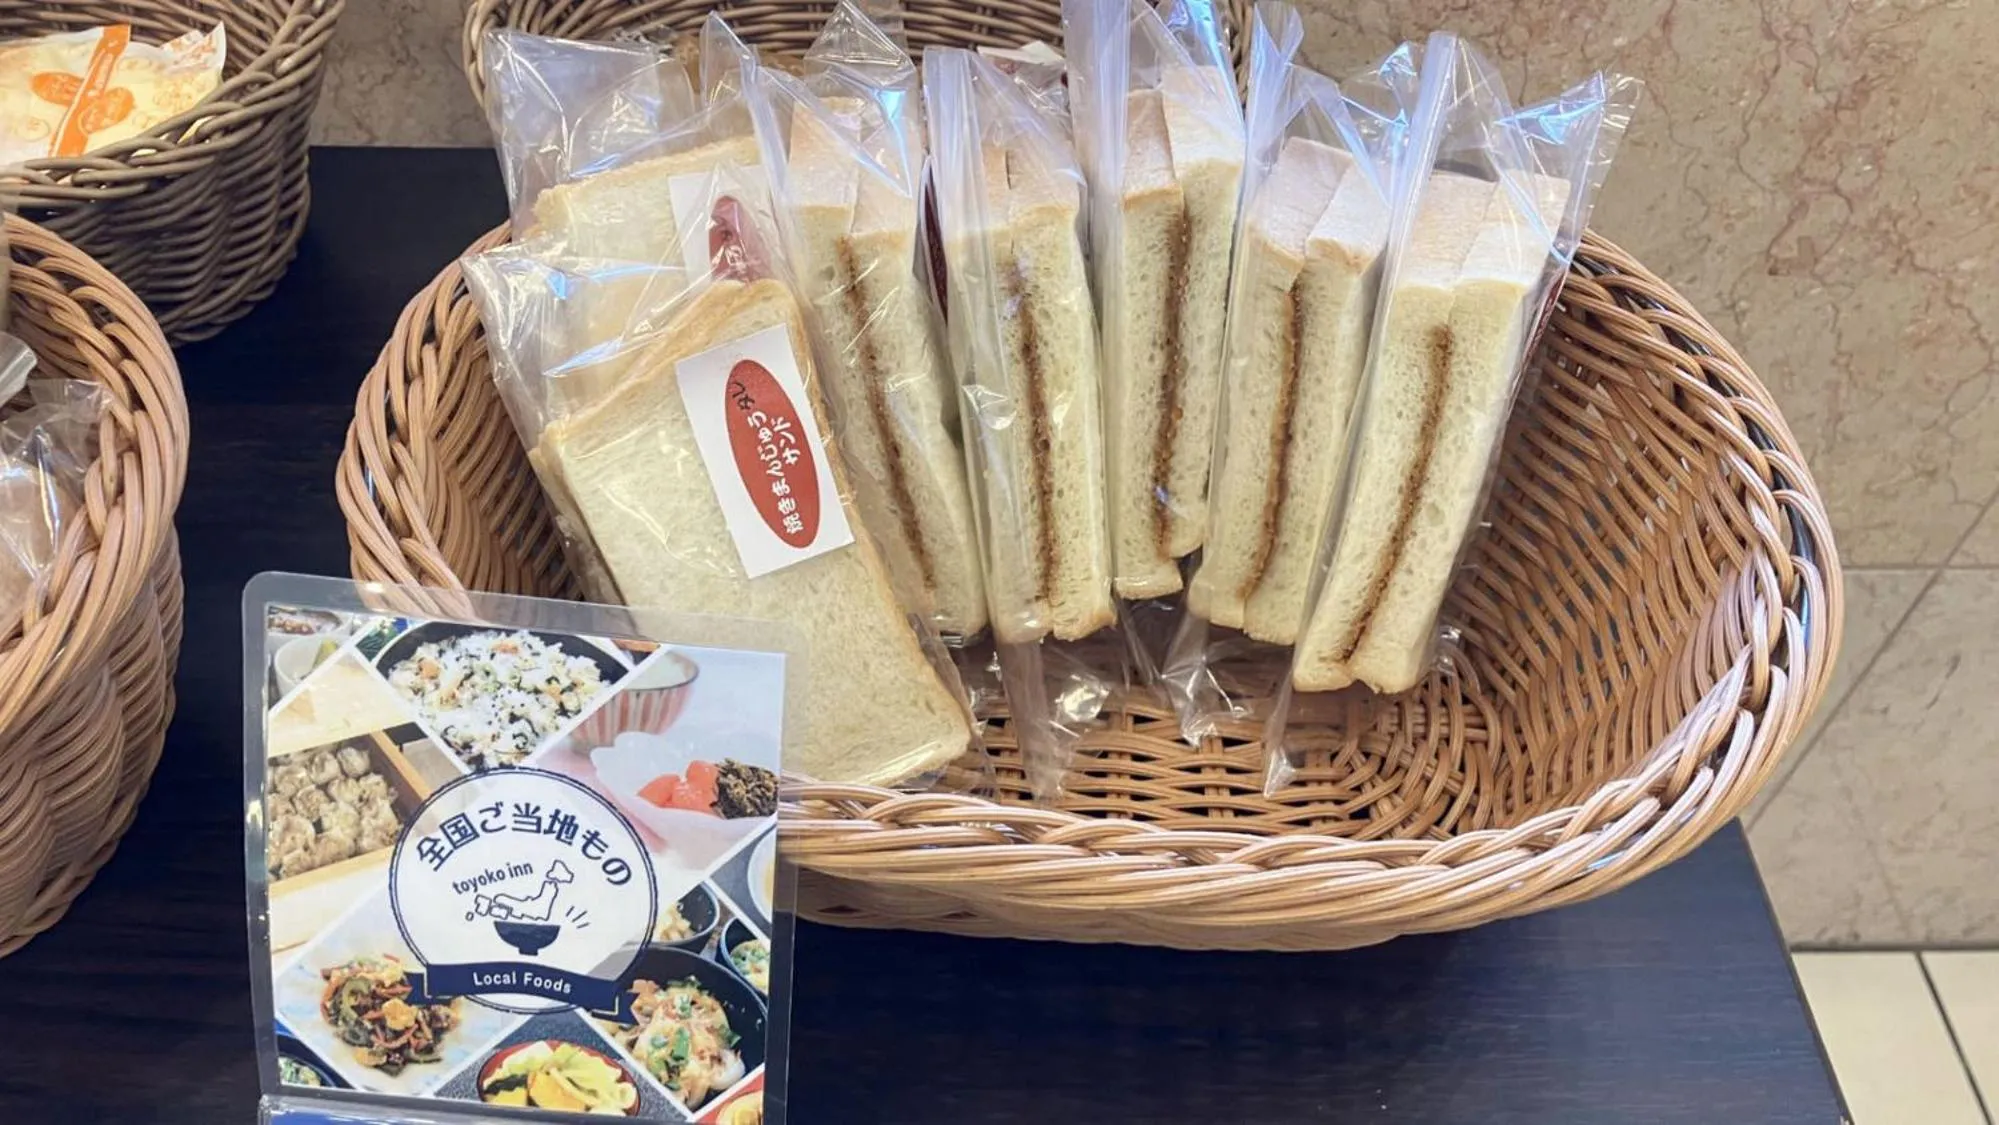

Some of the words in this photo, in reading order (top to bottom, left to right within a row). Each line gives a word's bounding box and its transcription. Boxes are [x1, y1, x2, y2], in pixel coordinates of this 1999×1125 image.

[770, 416, 801, 465] サンド
[747, 410, 804, 534] 焼きまんじゅう
[416, 801, 632, 886] 全国ご当地もの
[452, 865, 506, 895] toyoko
[508, 861, 534, 879] inn
[472, 971, 517, 986] Local
[523, 972, 572, 993] Foods
